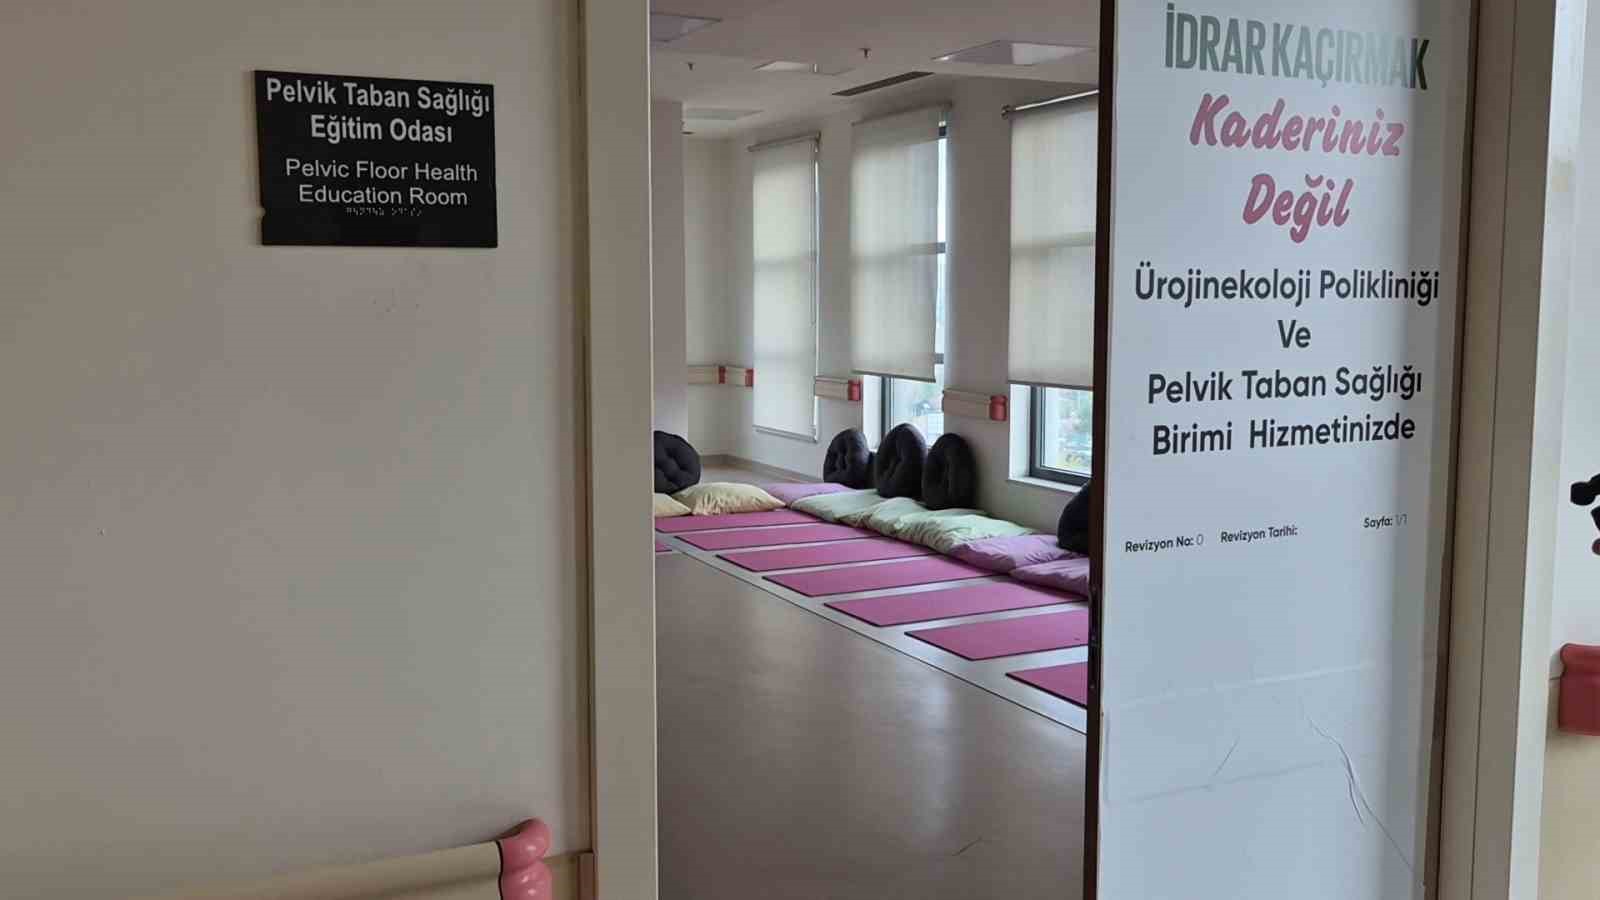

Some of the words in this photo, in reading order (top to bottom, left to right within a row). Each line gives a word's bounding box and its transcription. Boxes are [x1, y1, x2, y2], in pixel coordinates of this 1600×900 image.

[1164, 2, 1267, 76] İDRAR
[1271, 22, 1430, 90] KAÇIRMAK
[266, 77, 337, 105] Pelvik
[343, 82, 410, 109] Taban
[417, 86, 490, 117] Sağlığı
[311, 114, 383, 144] Eğitim
[390, 118, 452, 143] Odası
[1189, 92, 1405, 157] Kaderiniz
[286, 158, 350, 178] Pelvic
[356, 160, 408, 180] Floor
[415, 163, 478, 182] Health
[299, 184, 402, 205] Education
[409, 187, 468, 206] Room
[1242, 173, 1355, 243] Değil
[1135, 261, 1311, 308] Ürojinekoloji
[1319, 269, 1440, 306] Polikliniği
[1277, 319, 1312, 349] Ve
[1148, 371, 1233, 404] Pelvik
[1241, 369, 1327, 400] Taban
[1334, 364, 1423, 401] Sağlığı
[1152, 421, 1233, 455] Birimi
[1249, 412, 1416, 449] Hizmetinizde
[1220, 529, 1266, 543] Revizyon
[1268, 525, 1298, 538] Tarihi:
[1363, 516, 1393, 529] Sayfa:
[1125, 538, 1174, 553] Revizyon
[1176, 536, 1194, 548] No:
